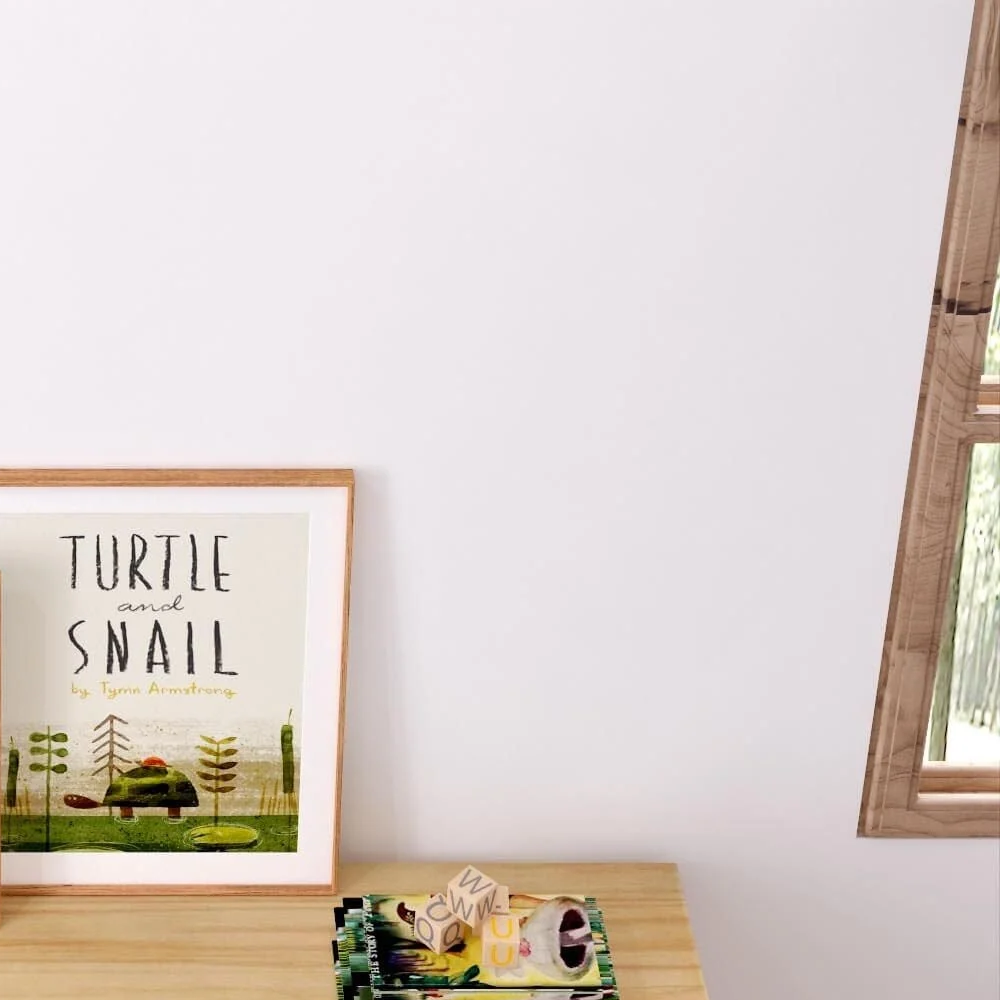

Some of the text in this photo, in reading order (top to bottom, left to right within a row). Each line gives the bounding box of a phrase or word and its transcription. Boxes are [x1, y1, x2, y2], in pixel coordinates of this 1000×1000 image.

[59, 534, 231, 592] TURTLE
[117, 595, 185, 613] and
[67, 620, 239, 675] SNAIL
[71, 682, 91, 699] by
[148, 682, 238, 699] Armstrong
[450, 889, 474, 921] W
[491, 917, 513, 938] U
[491, 944, 513, 966] U
